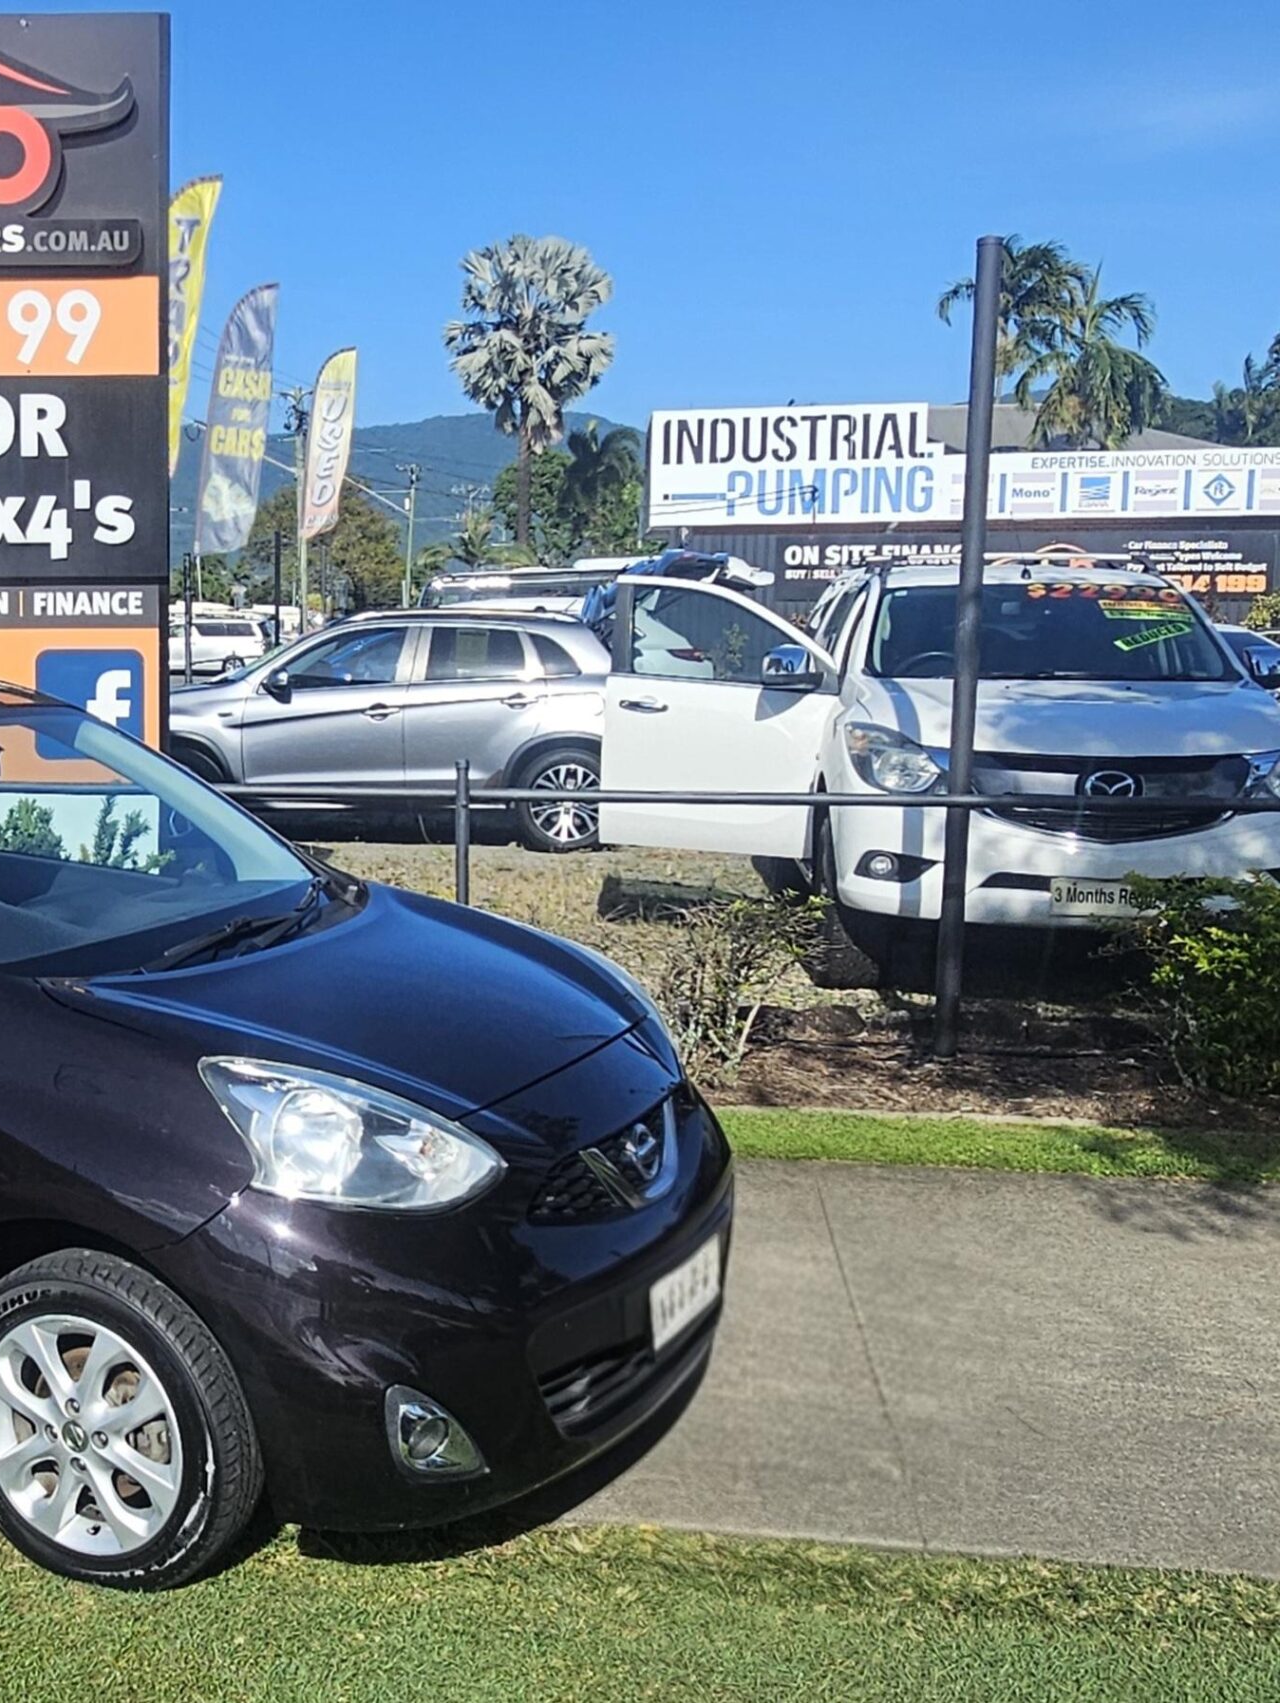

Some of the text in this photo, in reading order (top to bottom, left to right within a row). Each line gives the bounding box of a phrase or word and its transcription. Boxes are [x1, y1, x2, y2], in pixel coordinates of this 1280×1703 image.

[218, 368, 271, 402] CASH
[211, 424, 265, 462] CARS
[662, 412, 926, 464] INDUSTRIAL
[726, 465, 934, 517] PUMPING
[784, 545, 819, 565] ON
[882, 544, 963, 565] FINANC
[785, 569, 836, 580] BUY SELL
[1215, 574, 1267, 593] 199
[33, 591, 143, 616] FINANCE
[1121, 622, 1186, 647] REDUCED
[1054, 886, 1062, 902] 3
[1066, 886, 1115, 904] Months
